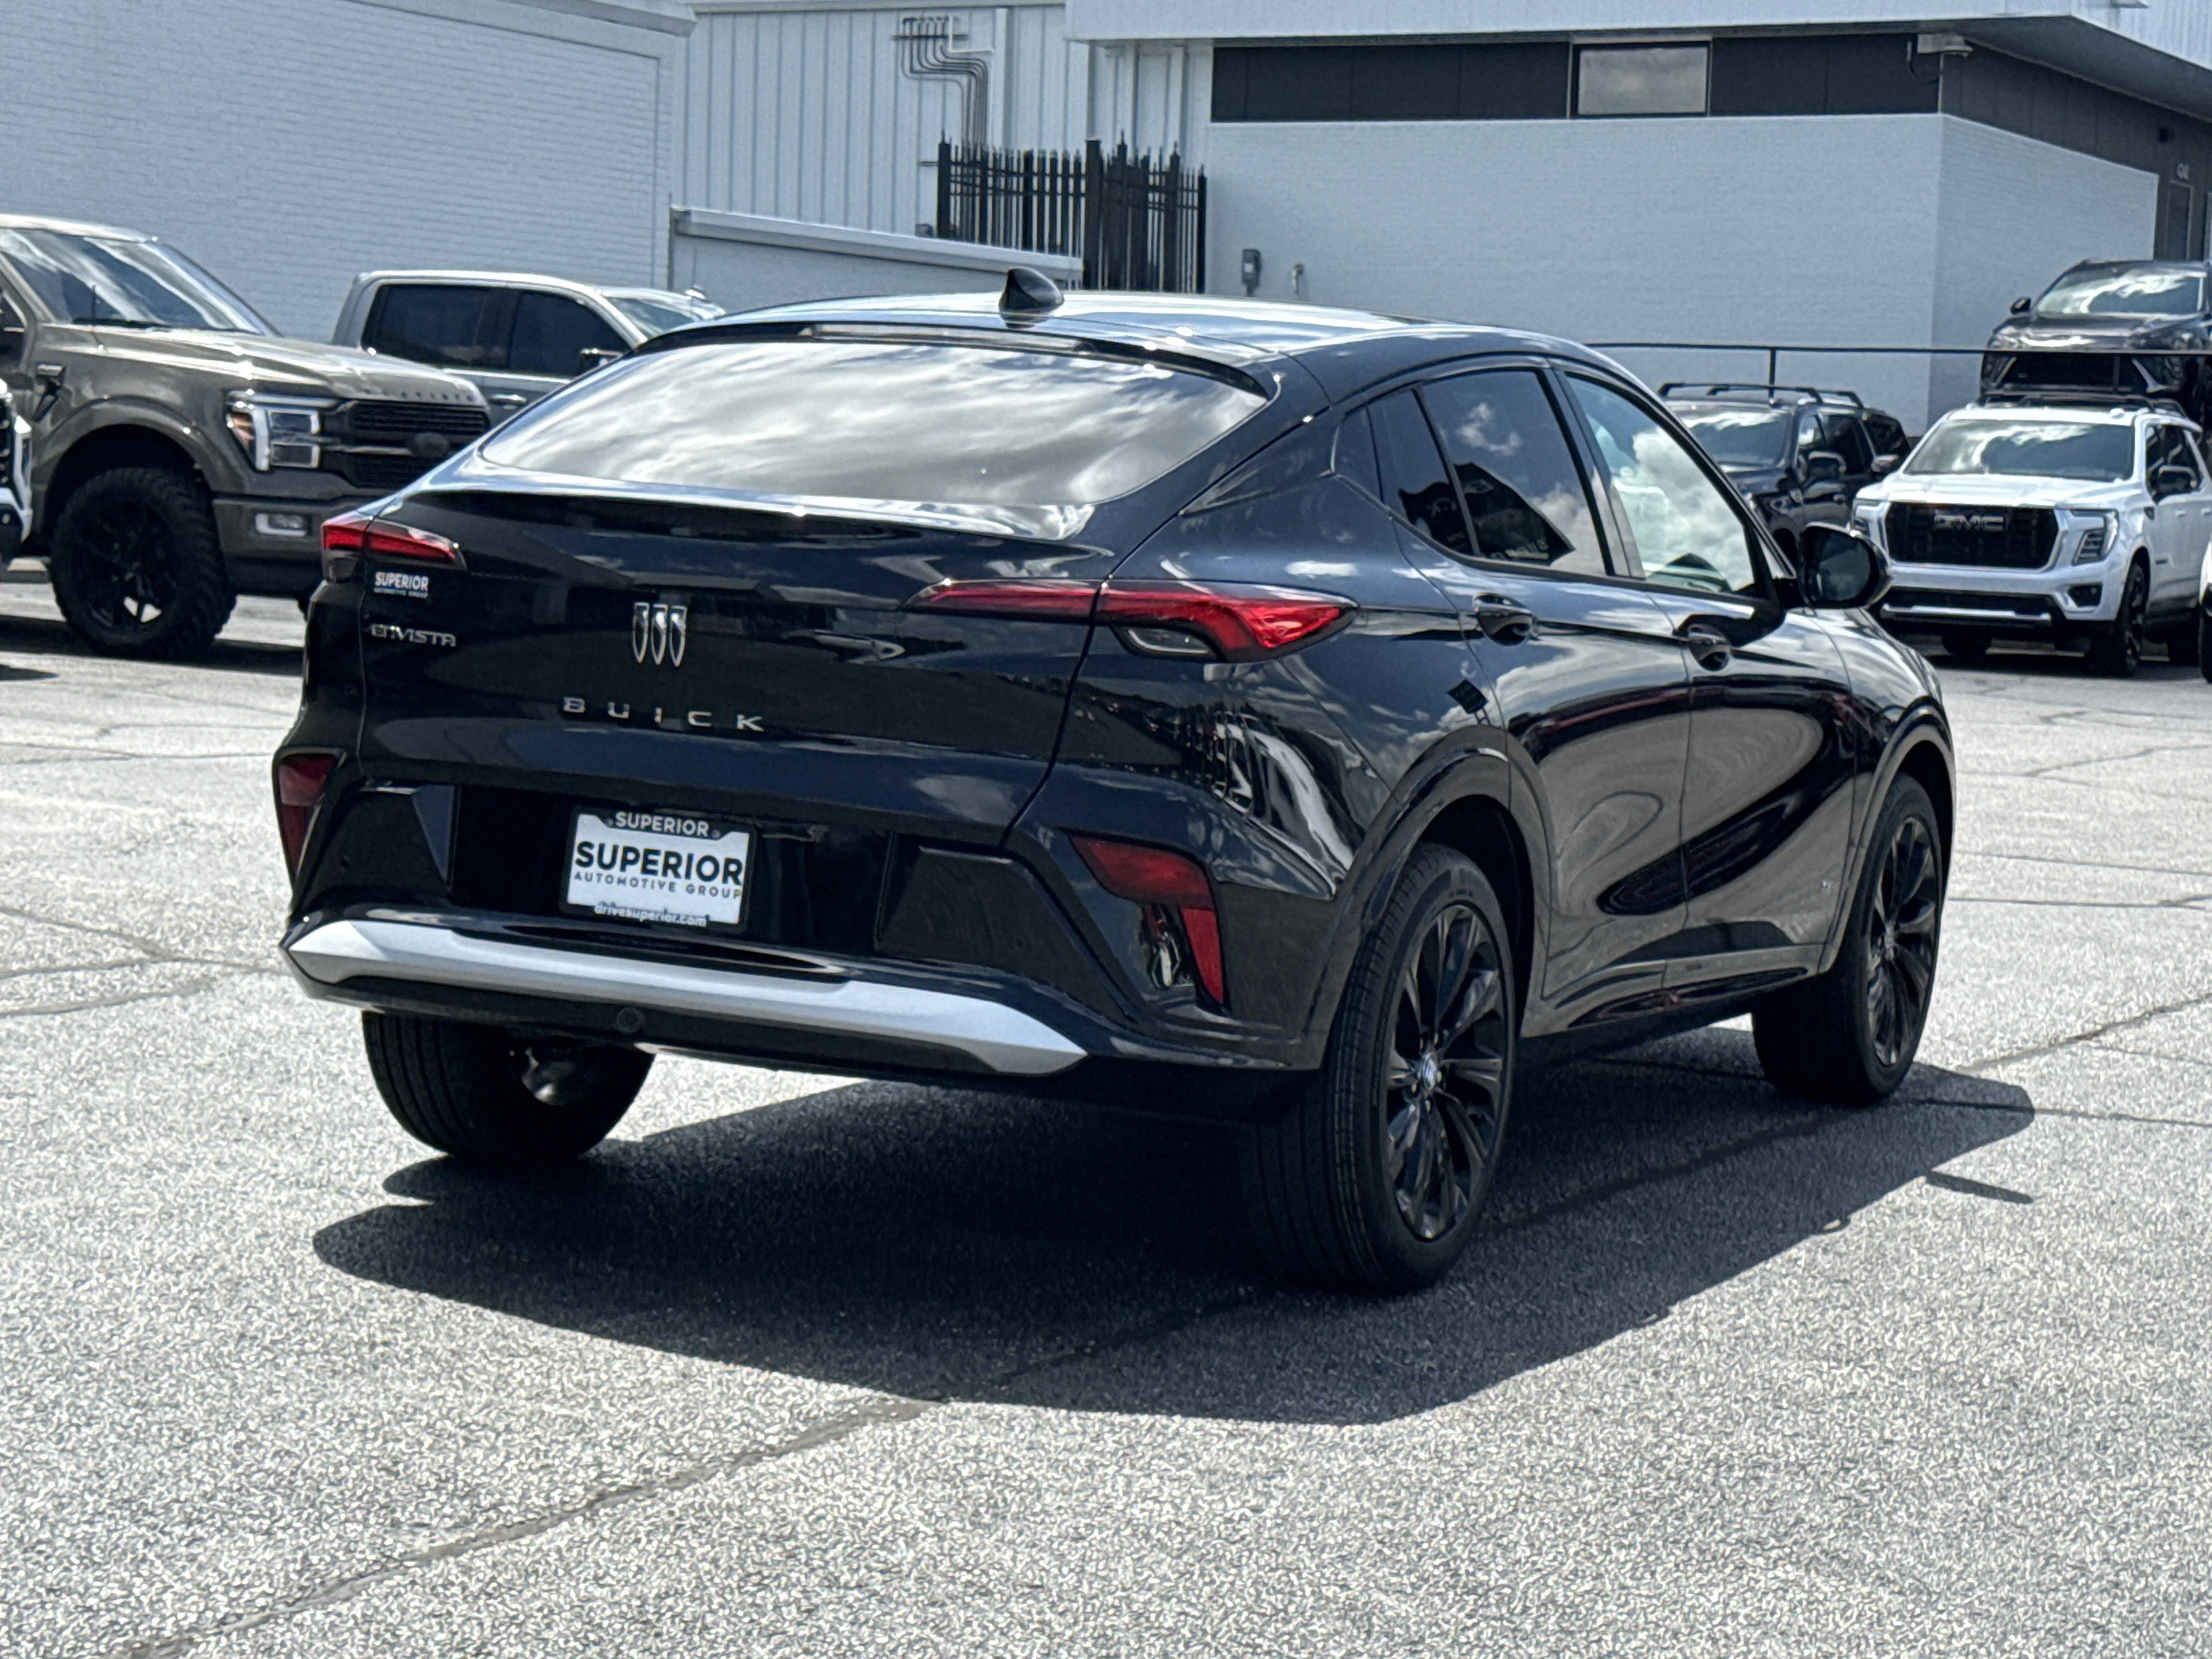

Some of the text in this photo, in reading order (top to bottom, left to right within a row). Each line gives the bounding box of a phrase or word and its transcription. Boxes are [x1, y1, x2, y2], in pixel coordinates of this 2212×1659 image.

[1934, 513, 2004, 531] GMC
[375, 571, 430, 591] SUPERIOR
[563, 696, 764, 732] BUICK
[614, 811, 709, 838] SUPERIOR
[575, 840, 743, 885] SUPERIOR
[574, 871, 741, 900] AUTOMOTIVE GROUP
